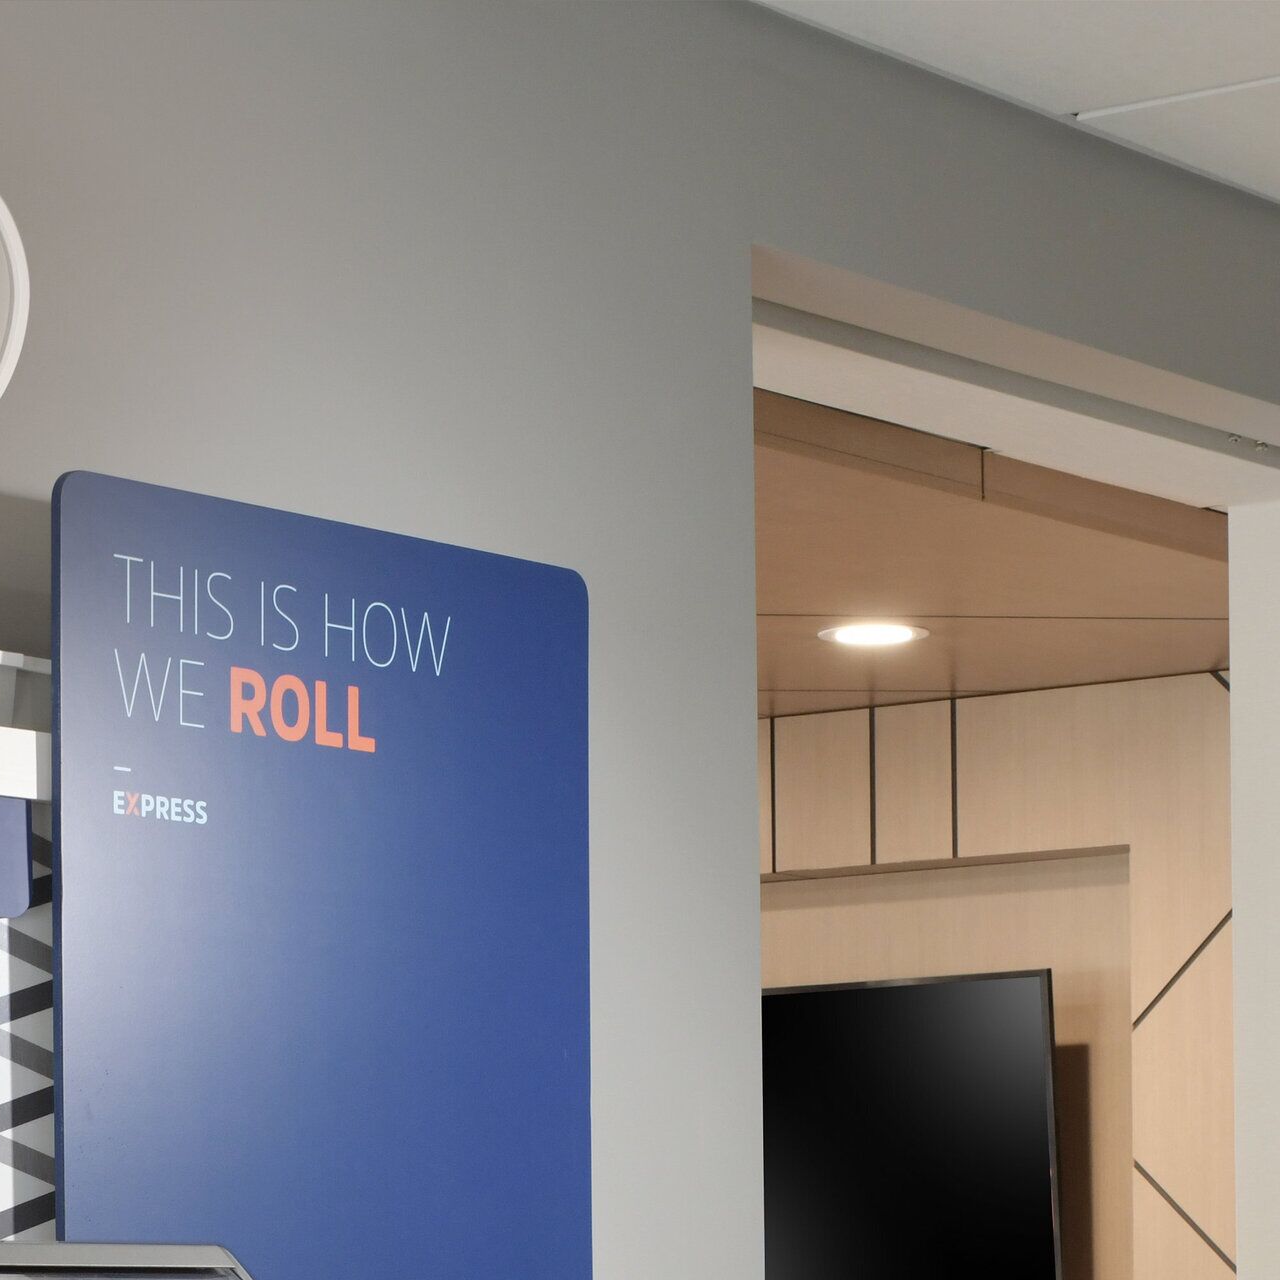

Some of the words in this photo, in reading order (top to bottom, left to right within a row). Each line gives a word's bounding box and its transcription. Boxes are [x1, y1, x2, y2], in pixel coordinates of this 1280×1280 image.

[113, 553, 234, 641] THIS
[260, 579, 300, 652] IS
[324, 591, 452, 677] HOW
[114, 648, 205, 729] WE
[230, 665, 376, 753] ROLL
[113, 789, 208, 825] EXPRESS
